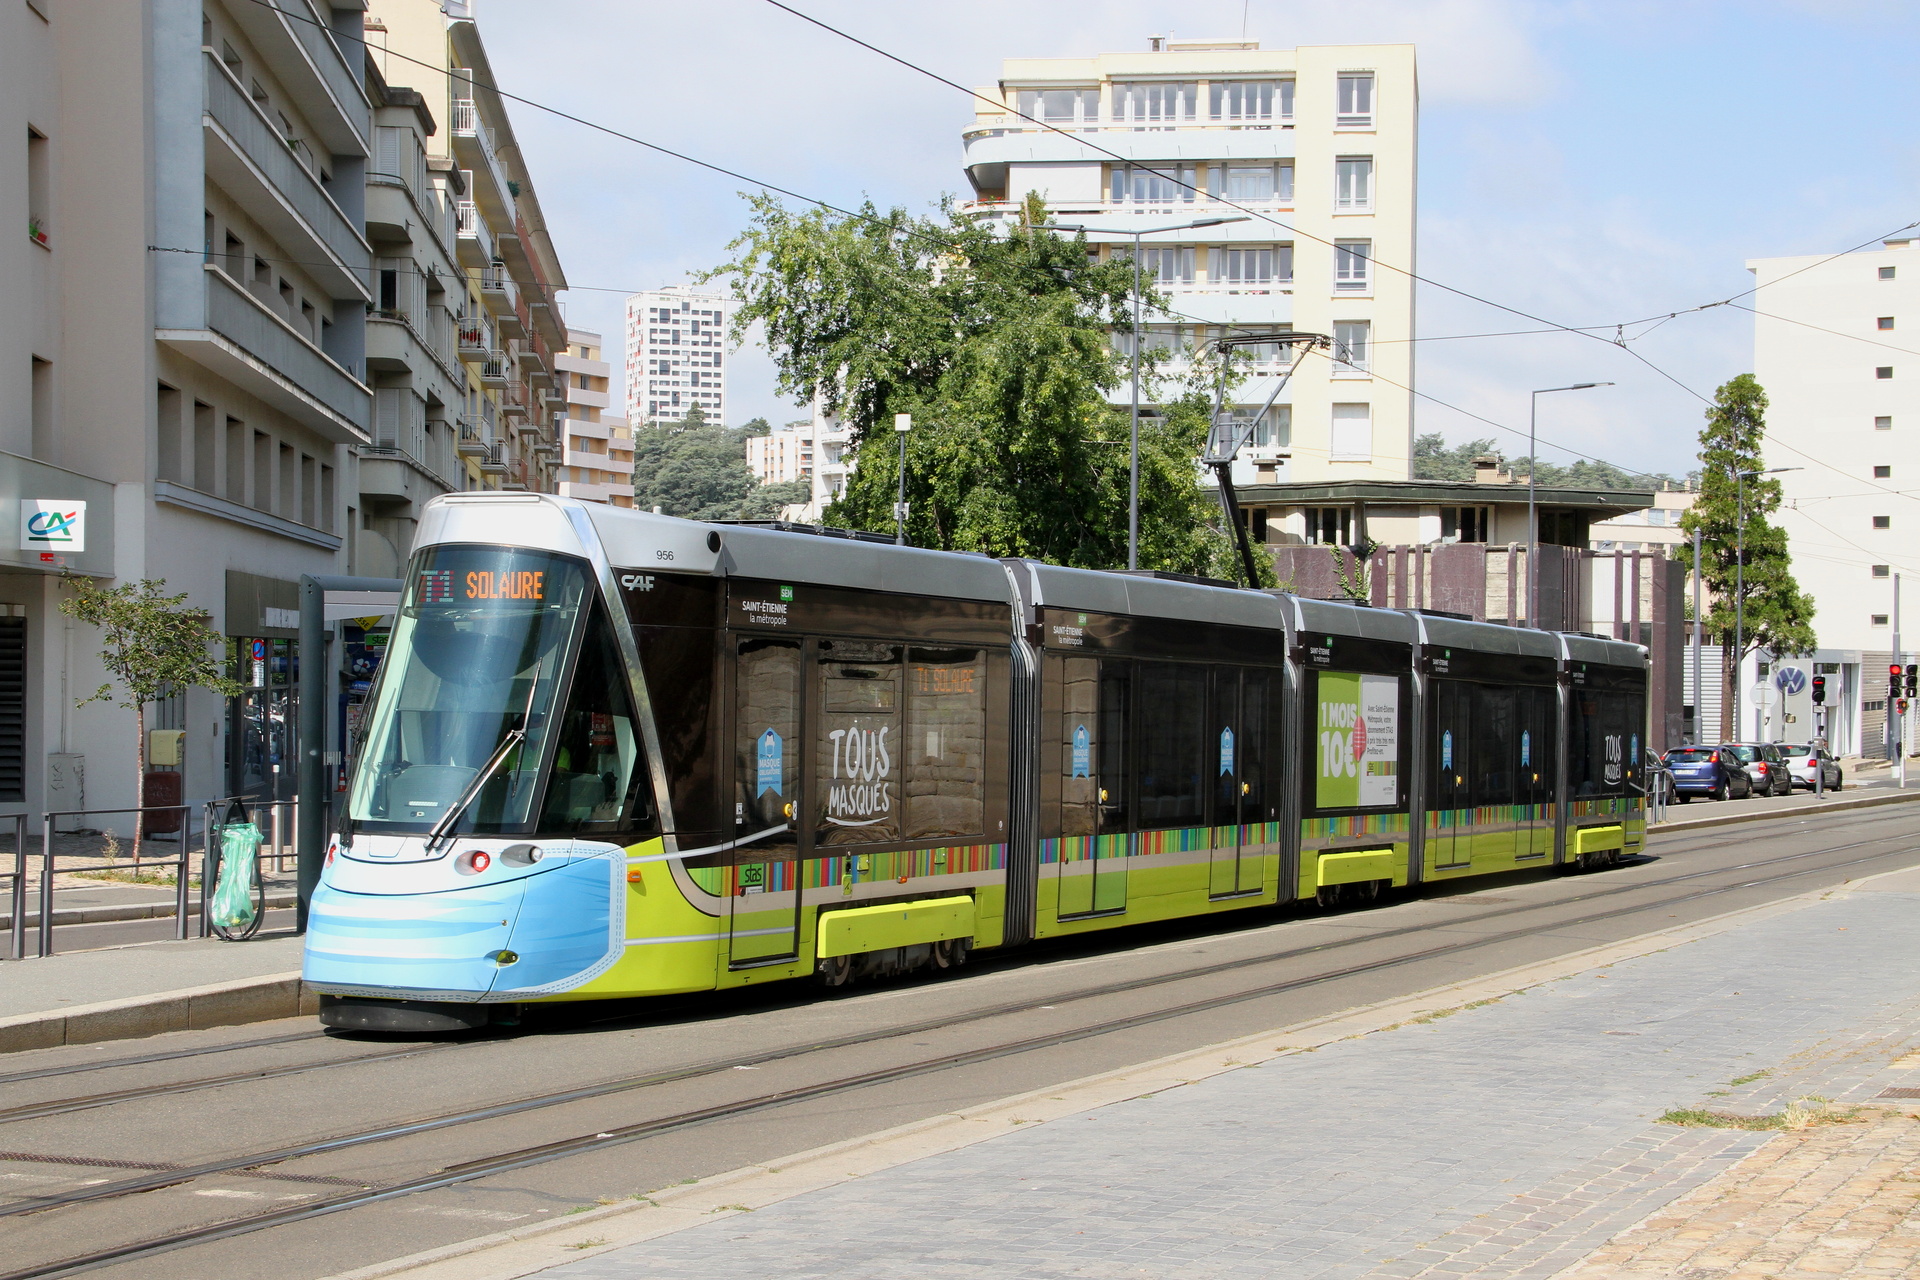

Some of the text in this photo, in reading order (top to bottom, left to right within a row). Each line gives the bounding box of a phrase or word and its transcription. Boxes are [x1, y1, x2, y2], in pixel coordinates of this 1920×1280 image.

[656, 550, 674, 561] 956
[465, 571, 544, 600] SOLAURE
[621, 574, 655, 592] CAF
[780, 587, 793, 599] SÉM
[742, 600, 788, 615] SAINT-ÉTIENNE
[749, 613, 787, 627] la métropole
[1053, 625, 1083, 637] SAINT-ÉTIENNE
[934, 668, 975, 693] SOLAURE
[1321, 702, 1357, 729] 1 MOIS
[829, 726, 890, 783] TOUS
[1321, 731, 1357, 778] 10€
[1605, 734, 1622, 763] TOUS
[759, 758, 781, 770] MASQUE
[828, 776, 890, 817] MASQUÉS
[744, 864, 763, 883] stas
